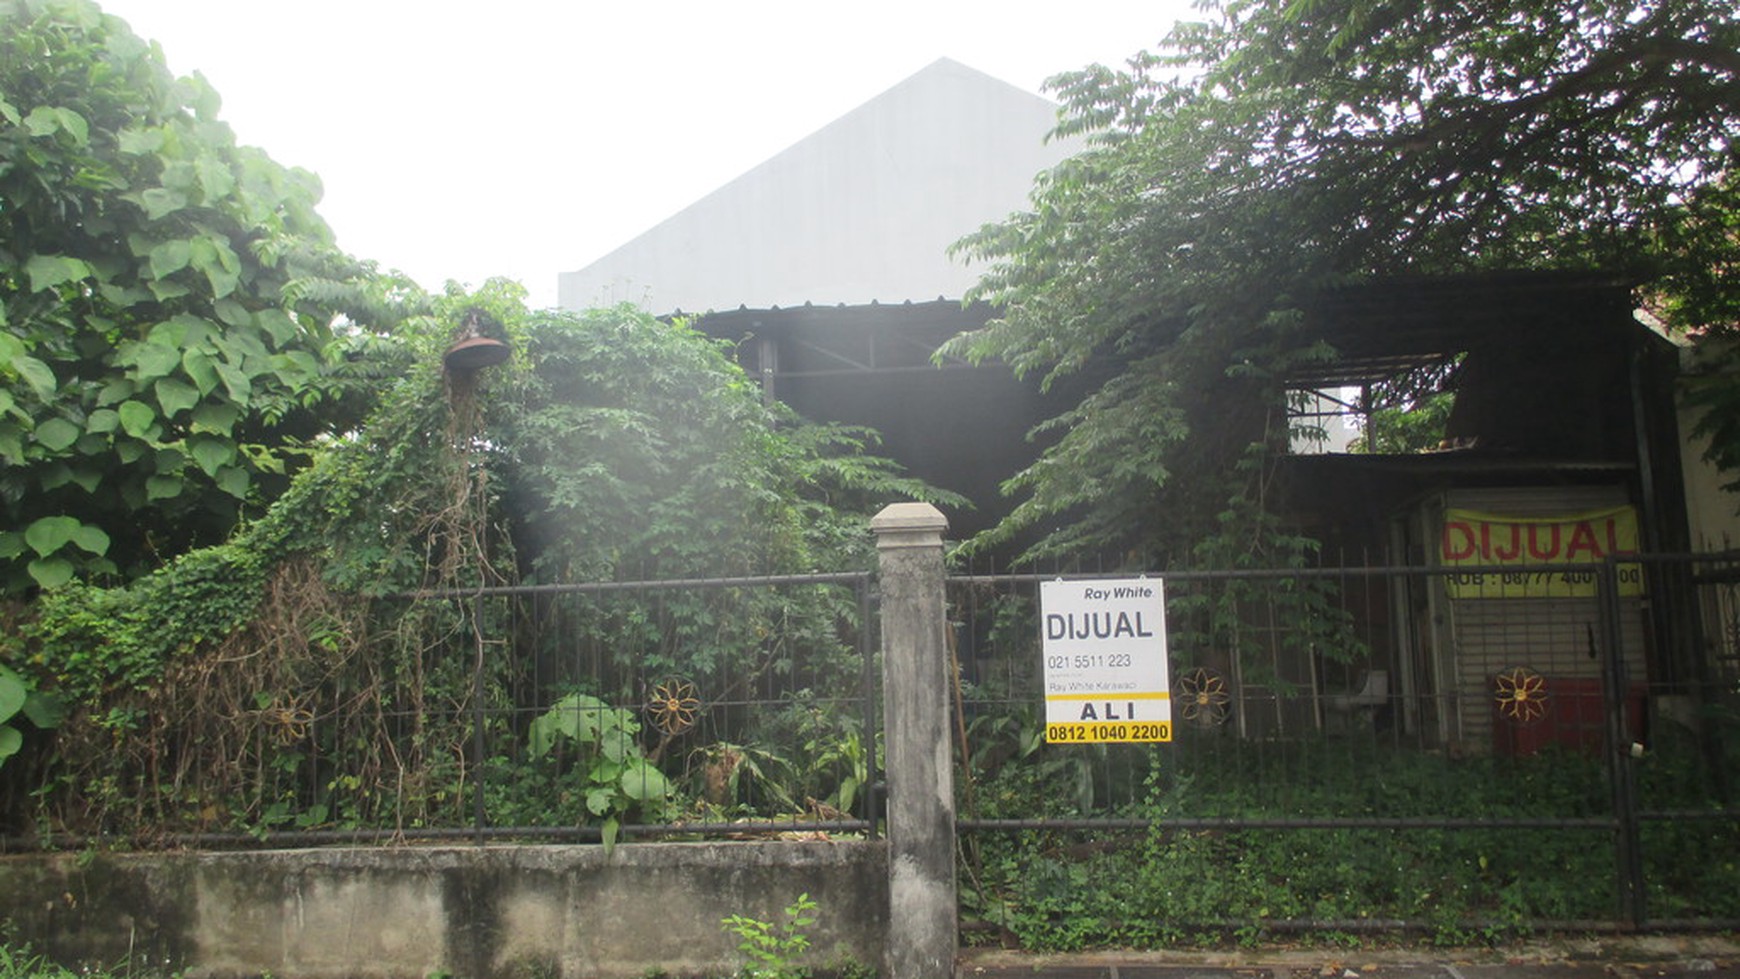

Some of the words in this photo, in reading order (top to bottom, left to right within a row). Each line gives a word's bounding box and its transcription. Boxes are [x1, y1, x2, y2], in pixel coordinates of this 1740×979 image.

[1442, 517, 1637, 561] DIJUAL
[1084, 587, 1110, 601] Ray
[1113, 586, 1153, 599] White
[1046, 611, 1153, 640] DIJUAL
[1048, 655, 1070, 669] 021
[1074, 655, 1103, 669] 5511
[1108, 653, 1131, 668] 223
[1049, 682, 1066, 692] Ray
[1069, 681, 1095, 691] White
[1079, 701, 1135, 721] ALI
[1049, 726, 1086, 740] 0812
[1090, 725, 1127, 740] 1040
[1131, 724, 1169, 740] 2200
